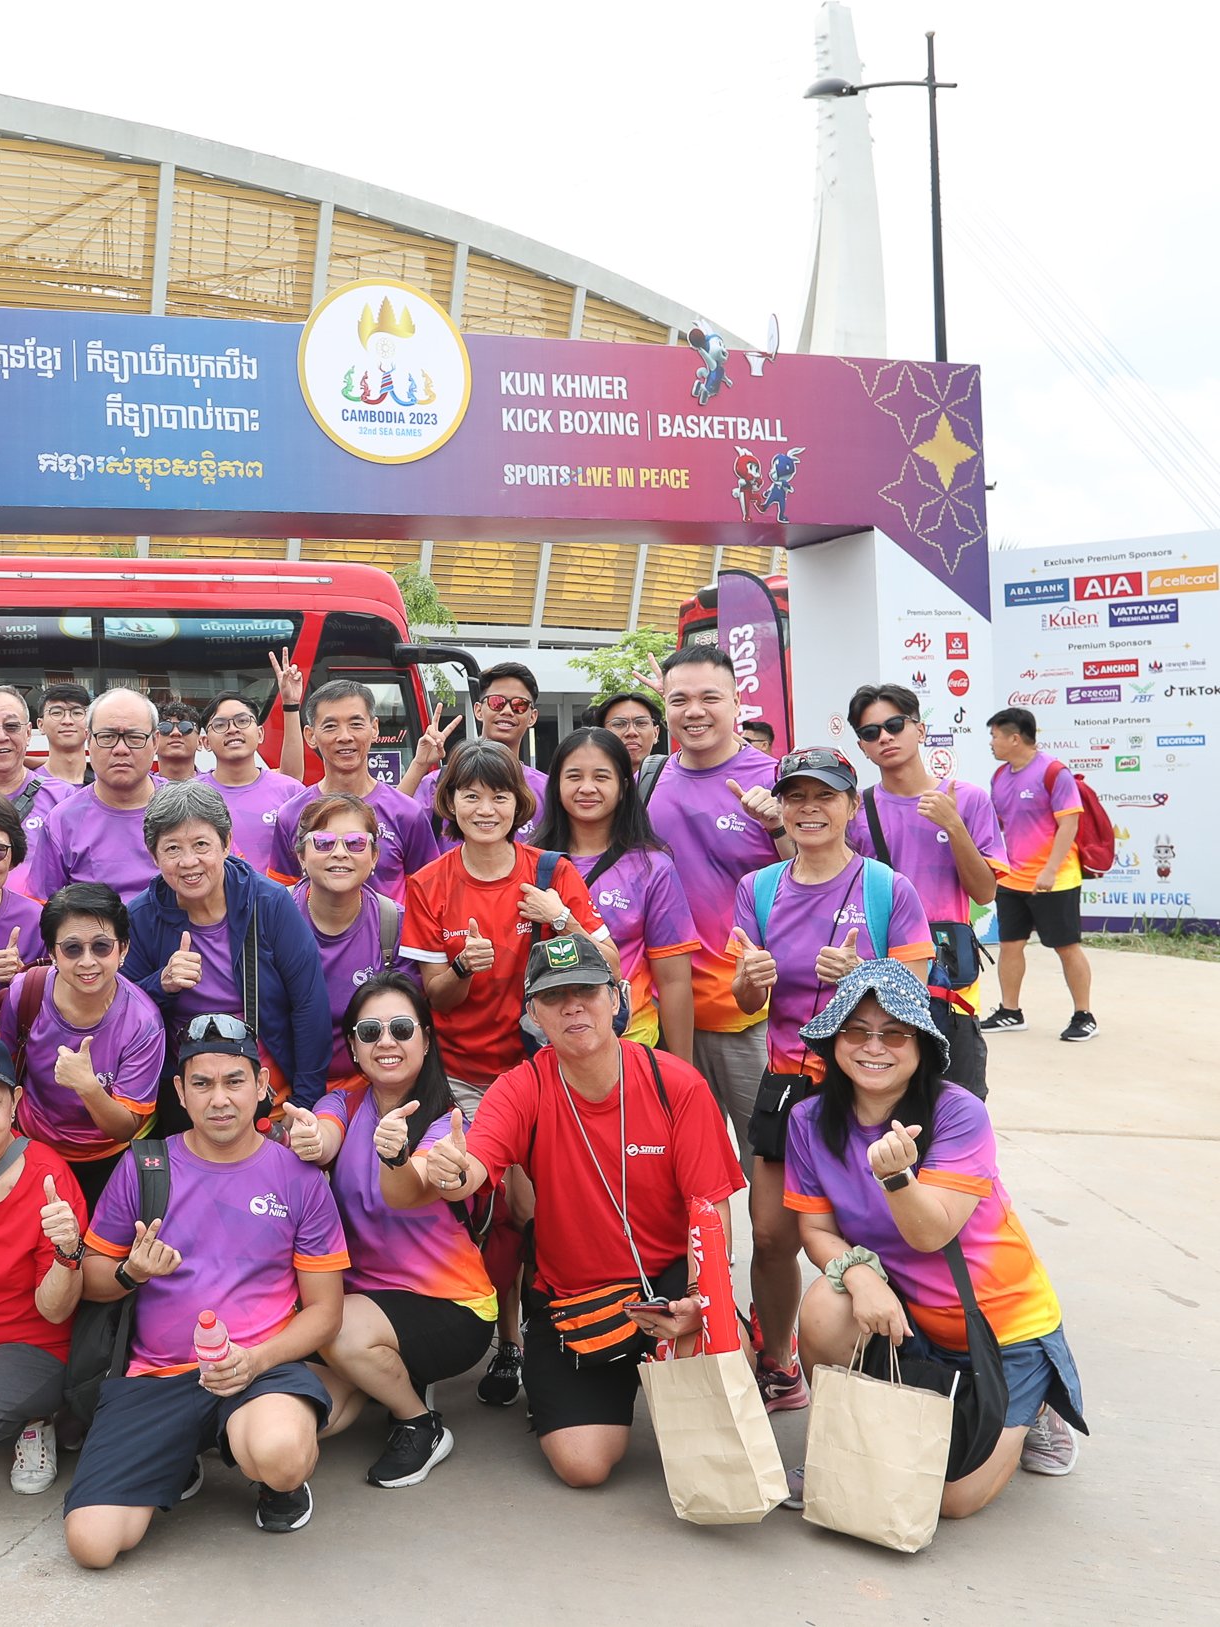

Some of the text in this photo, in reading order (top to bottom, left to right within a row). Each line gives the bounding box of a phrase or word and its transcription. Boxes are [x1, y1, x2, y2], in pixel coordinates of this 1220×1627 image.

[499, 371, 628, 400] KUN KHMER
[341, 408, 438, 425] CAMBODIA 2023
[501, 407, 788, 442] KICK BOXING BASKETBALL
[358, 426, 422, 437] 32nd SEA GAMES
[616, 467, 635, 487] IN
[639, 468, 690, 489] PEACE
[1043, 549, 1173, 567] Exclusive Premium Sponsors
[1163, 572, 1217, 587] cellcard
[1035, 583, 1065, 594] BANK
[1083, 576, 1134, 598] AIA
[934, 609, 962, 617] Sponsors
[1110, 603, 1177, 616] VATTANAC
[1049, 611, 1098, 628] Kulen
[1117, 613, 1170, 623] PREMIUM BEER
[1068, 639, 1152, 651] Premium Sponsors
[1100, 664, 1137, 674] ANCHOR
[1081, 688, 1119, 698] ezecom
[1178, 685, 1220, 697] TikTok
[1130, 694, 1155, 704] FBT
[1074, 717, 1151, 726] National Partners
[949, 726, 972, 734] TikTok
[1053, 741, 1080, 749] MALL
[1089, 737, 1116, 745] CLEAR
[1133, 892, 1146, 905] IN
[1151, 892, 1192, 906] PEACE
[612, 901, 628, 910] Nila
[450, 929, 470, 937] UNITE
[639, 1145, 666, 1154] SMRT
[270, 1202, 289, 1211] Team
[268, 1208, 287, 1218] Nila
